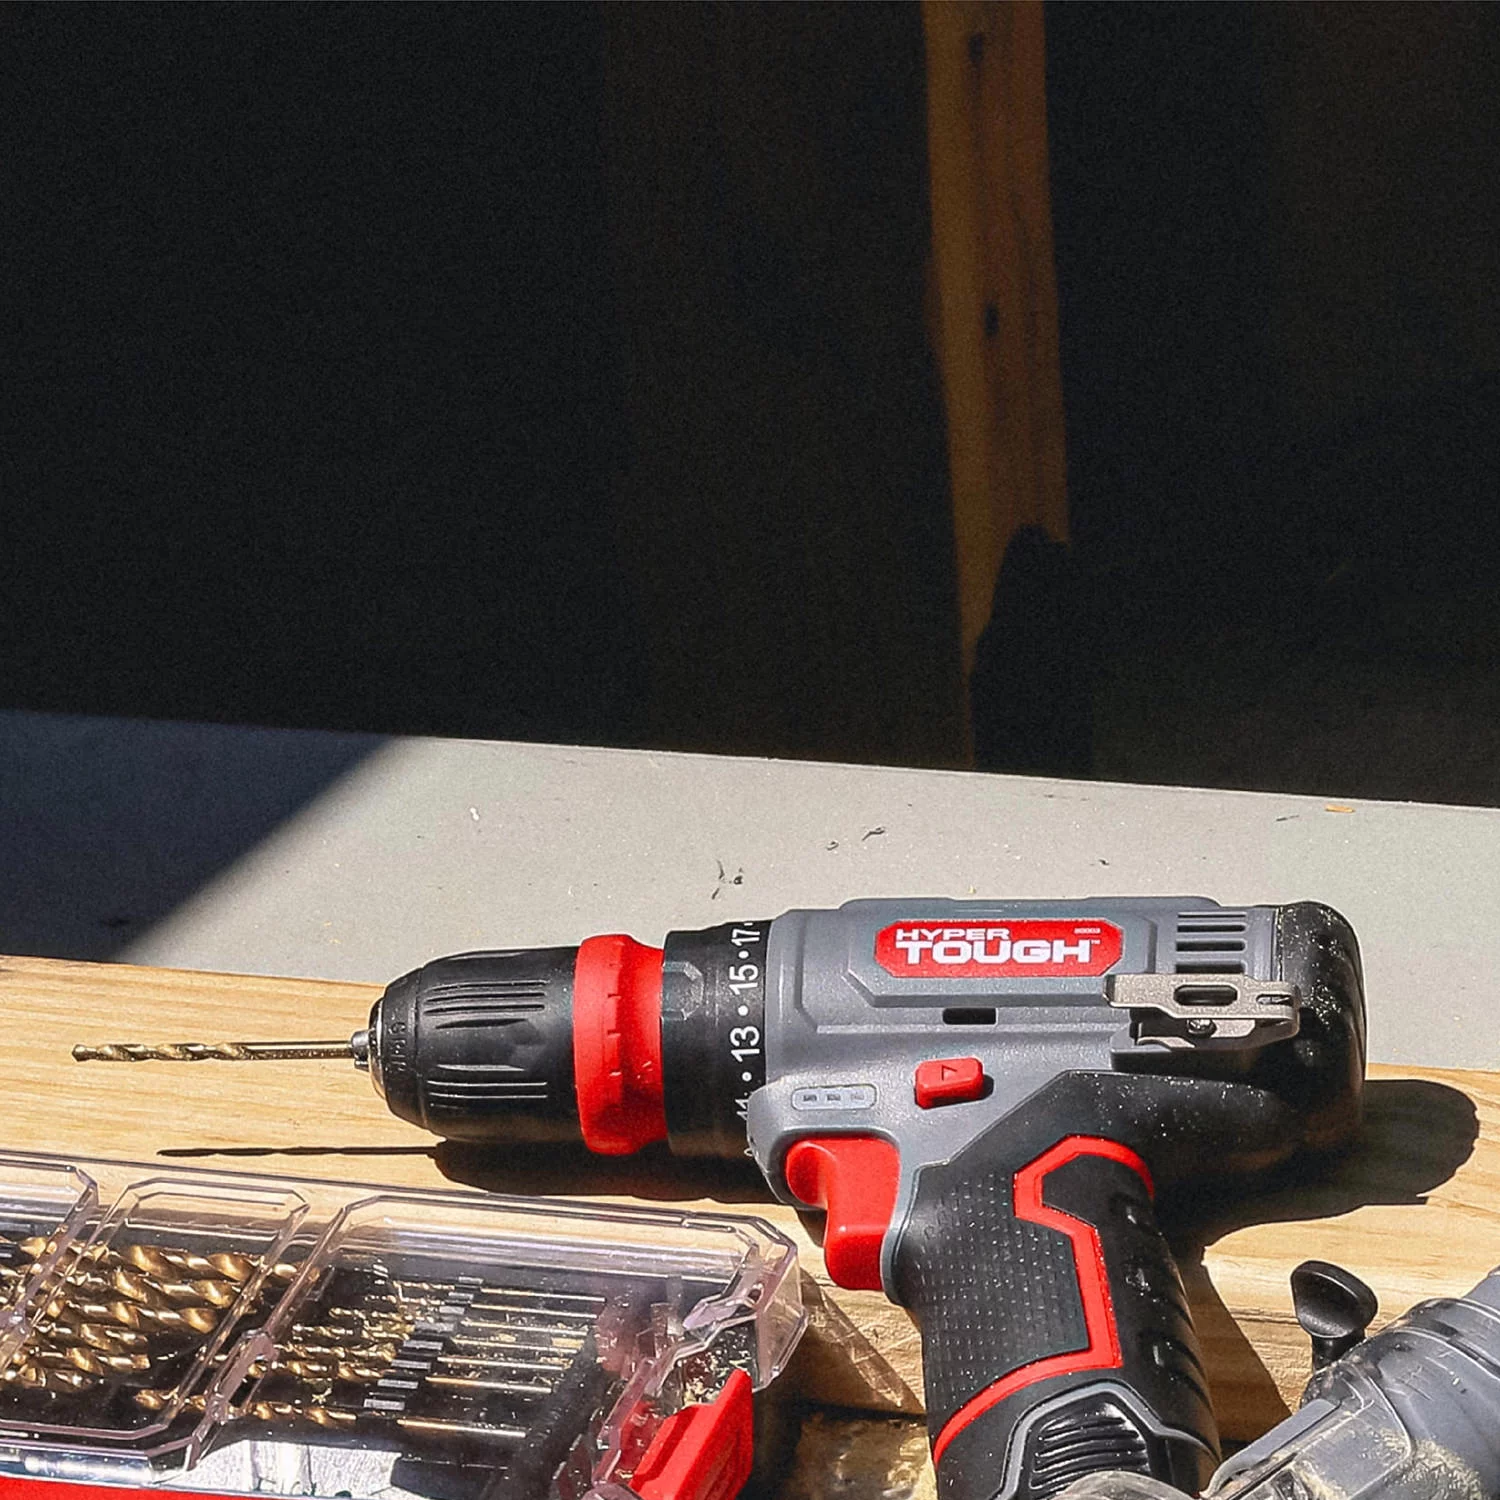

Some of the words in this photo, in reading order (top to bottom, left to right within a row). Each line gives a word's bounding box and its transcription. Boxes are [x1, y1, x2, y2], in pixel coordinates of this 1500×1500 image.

[731, 928, 760, 947] 17
[896, 928, 1010, 941] HYPER
[896, 940, 1091, 965] TOUGH
[729, 963, 759, 996] 15
[730, 1025, 760, 1063] 13
